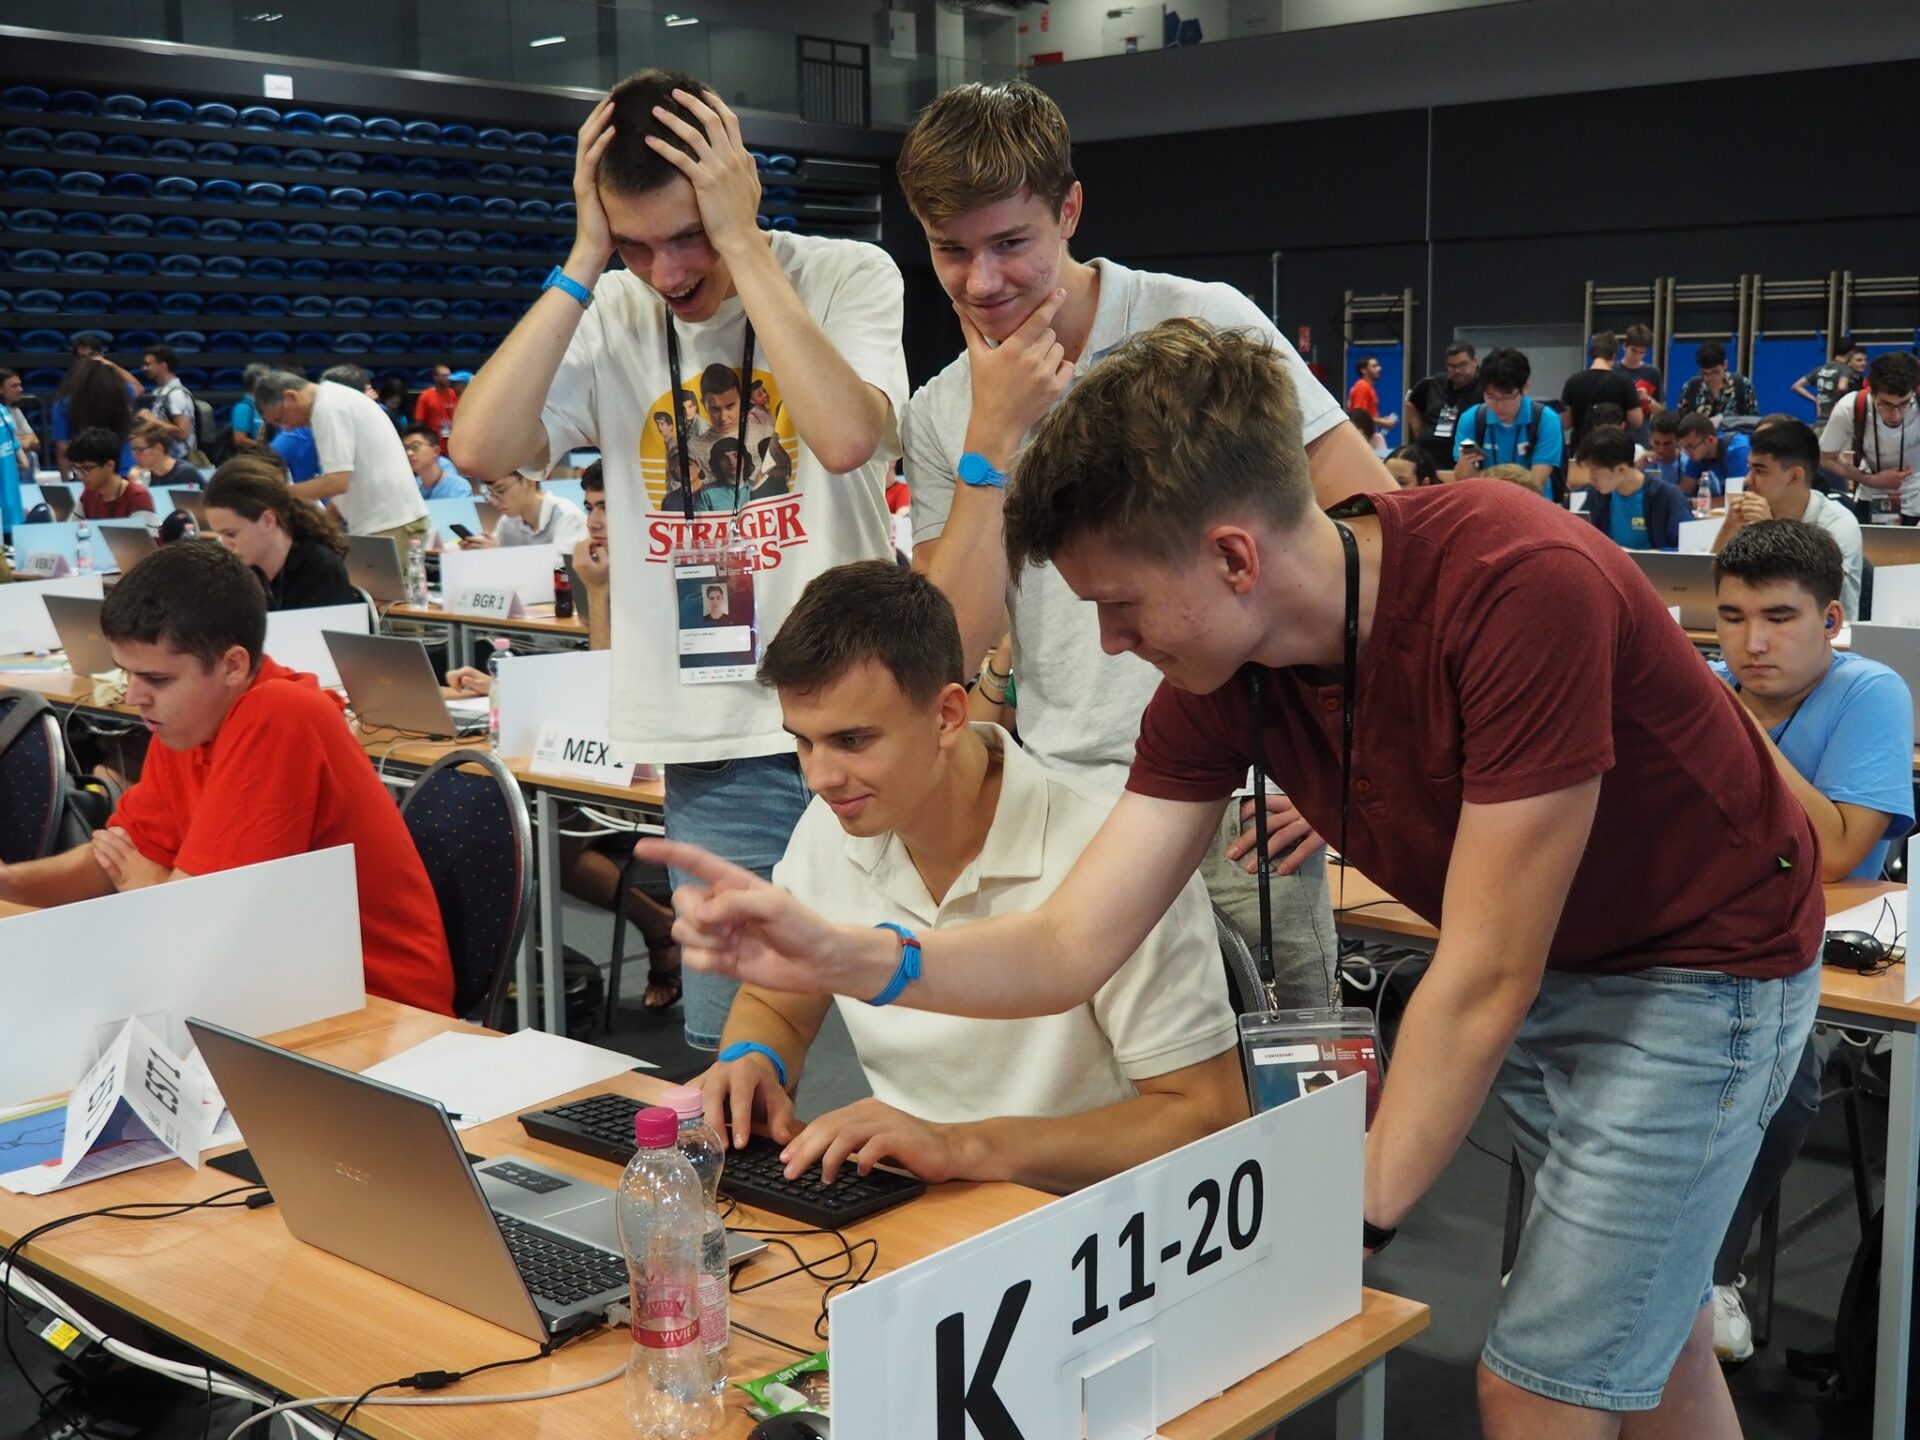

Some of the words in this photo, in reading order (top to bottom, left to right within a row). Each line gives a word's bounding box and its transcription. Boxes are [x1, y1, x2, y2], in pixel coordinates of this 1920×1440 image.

[649, 502, 807, 556] STRAGER
[473, 593, 496, 609] BGR
[497, 596, 504, 610] 1
[563, 738, 609, 766] MEX
[149, 1047, 181, 1080] 1
[145, 1059, 179, 1115] EST
[936, 1279, 1032, 1440] K
[1071, 1159, 1264, 1336] 11-20
